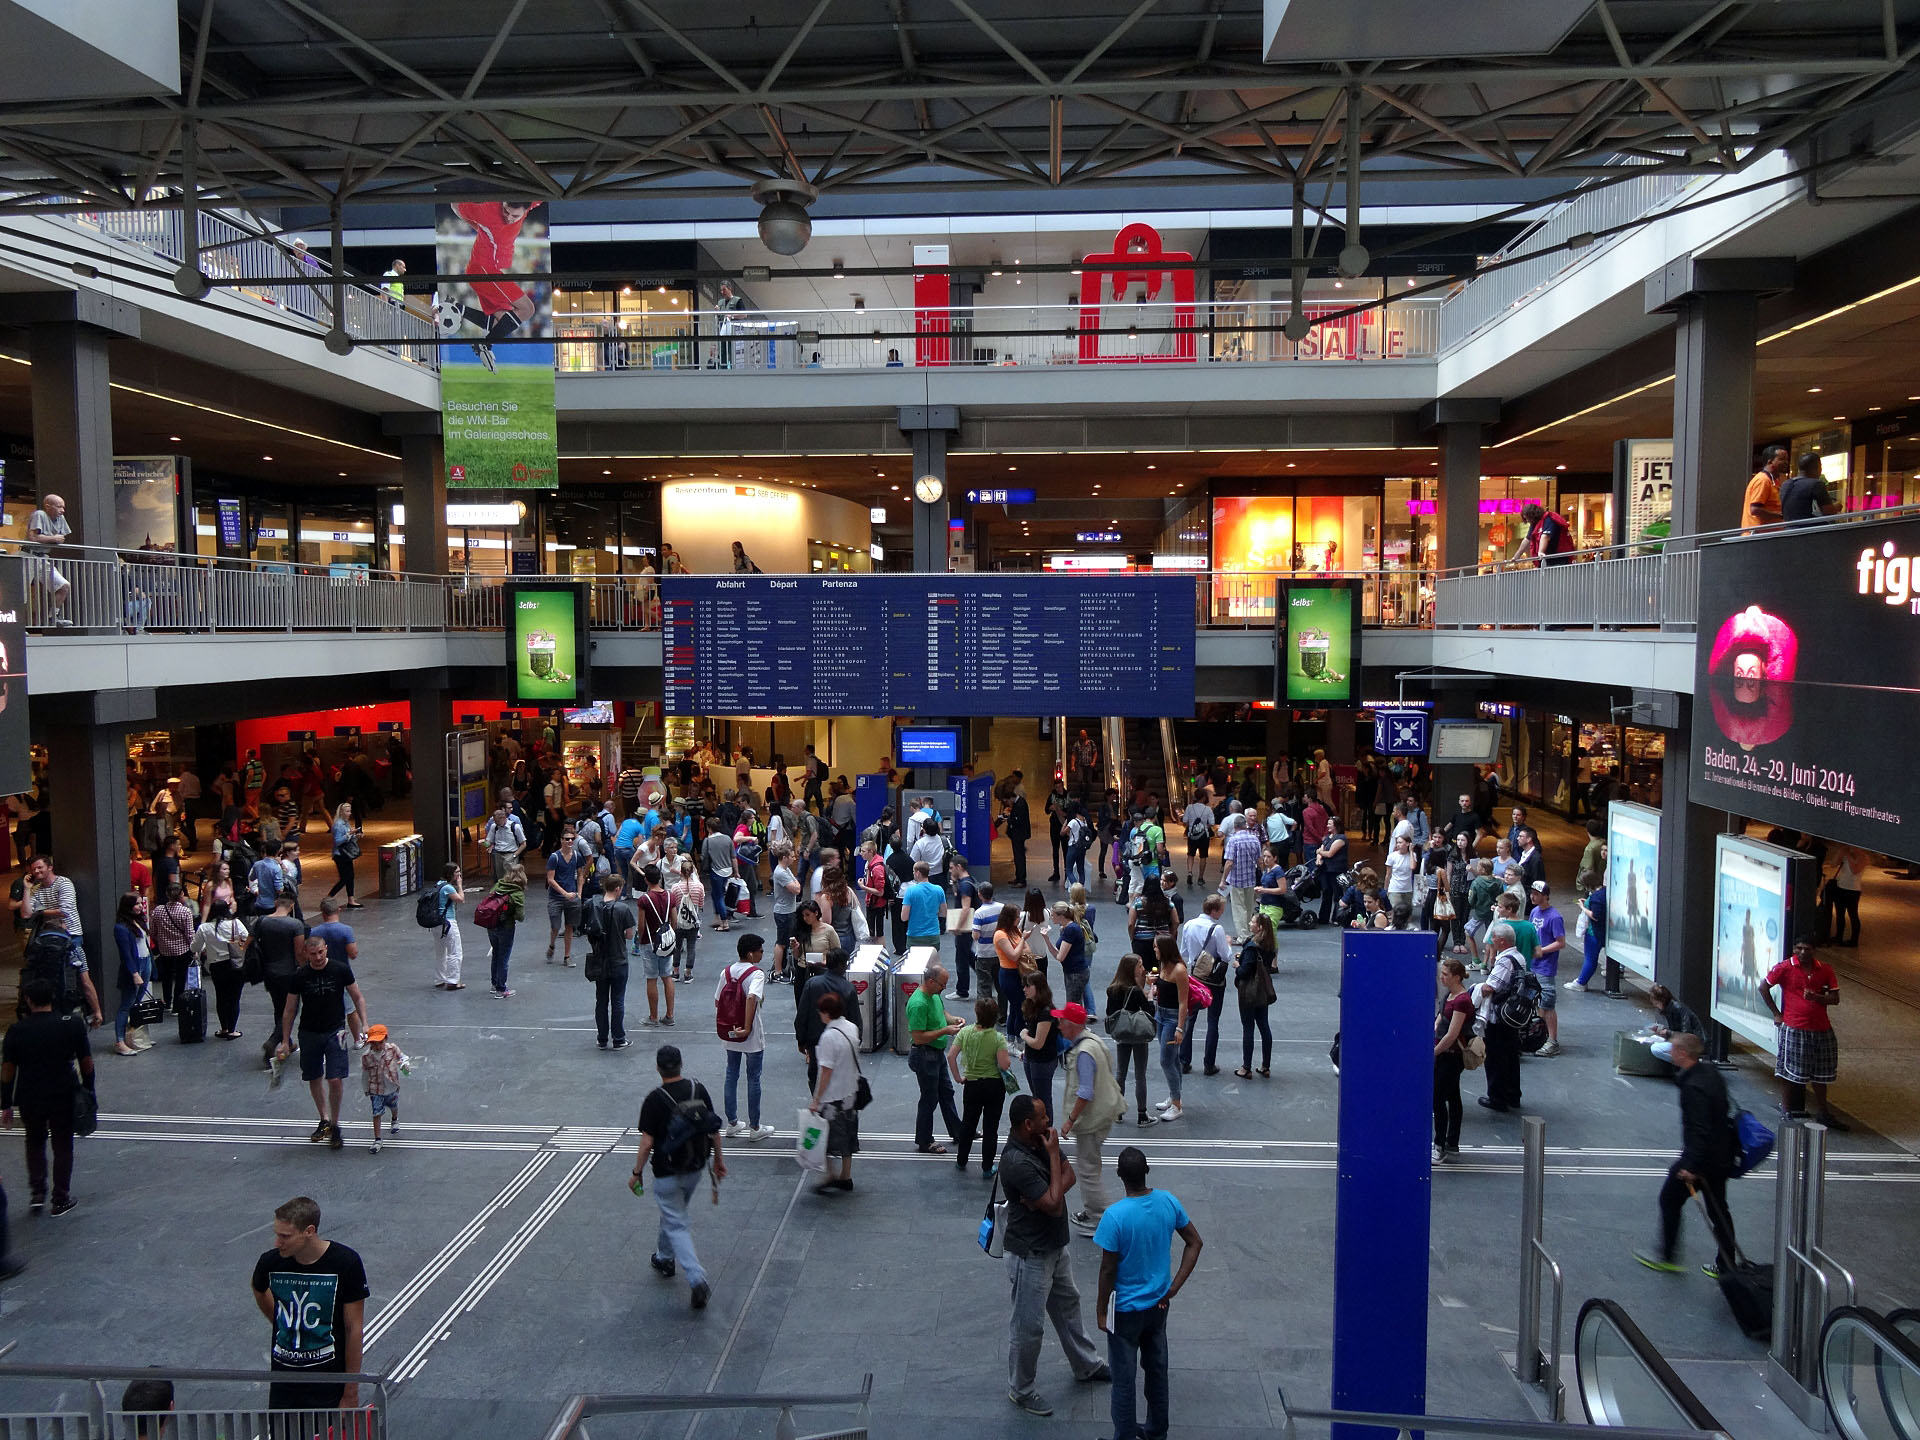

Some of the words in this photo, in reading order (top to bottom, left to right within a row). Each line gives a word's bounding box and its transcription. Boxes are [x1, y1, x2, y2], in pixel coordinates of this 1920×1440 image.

[1417, 263, 1446, 272] ESPRIT
[1300, 327, 1405, 358] SALE
[448, 401, 499, 411] Besuchen
[501, 401, 518, 411] Sie
[448, 415, 463, 425] die
[466, 415, 509, 425] WM-Bar
[448, 430, 461, 439] im
[463, 429, 550, 442] Galeriegeschoss.
[716, 580, 746, 589] Abfahrt
[770, 580, 798, 590] Départ
[822, 580, 858, 588] Partenza
[1705, 746, 1740, 774] Baden,
[1789, 762, 1816, 788] Juni
[1819, 769, 1855, 797] 2014
[1772, 786, 1783, 796] des
[1830, 800, 1843, 811] und
[1845, 801, 1900, 824] Figurentheaters
[278, 1290, 321, 1349] NYC
[280, 1348, 320, 1359] BROOKLYN
